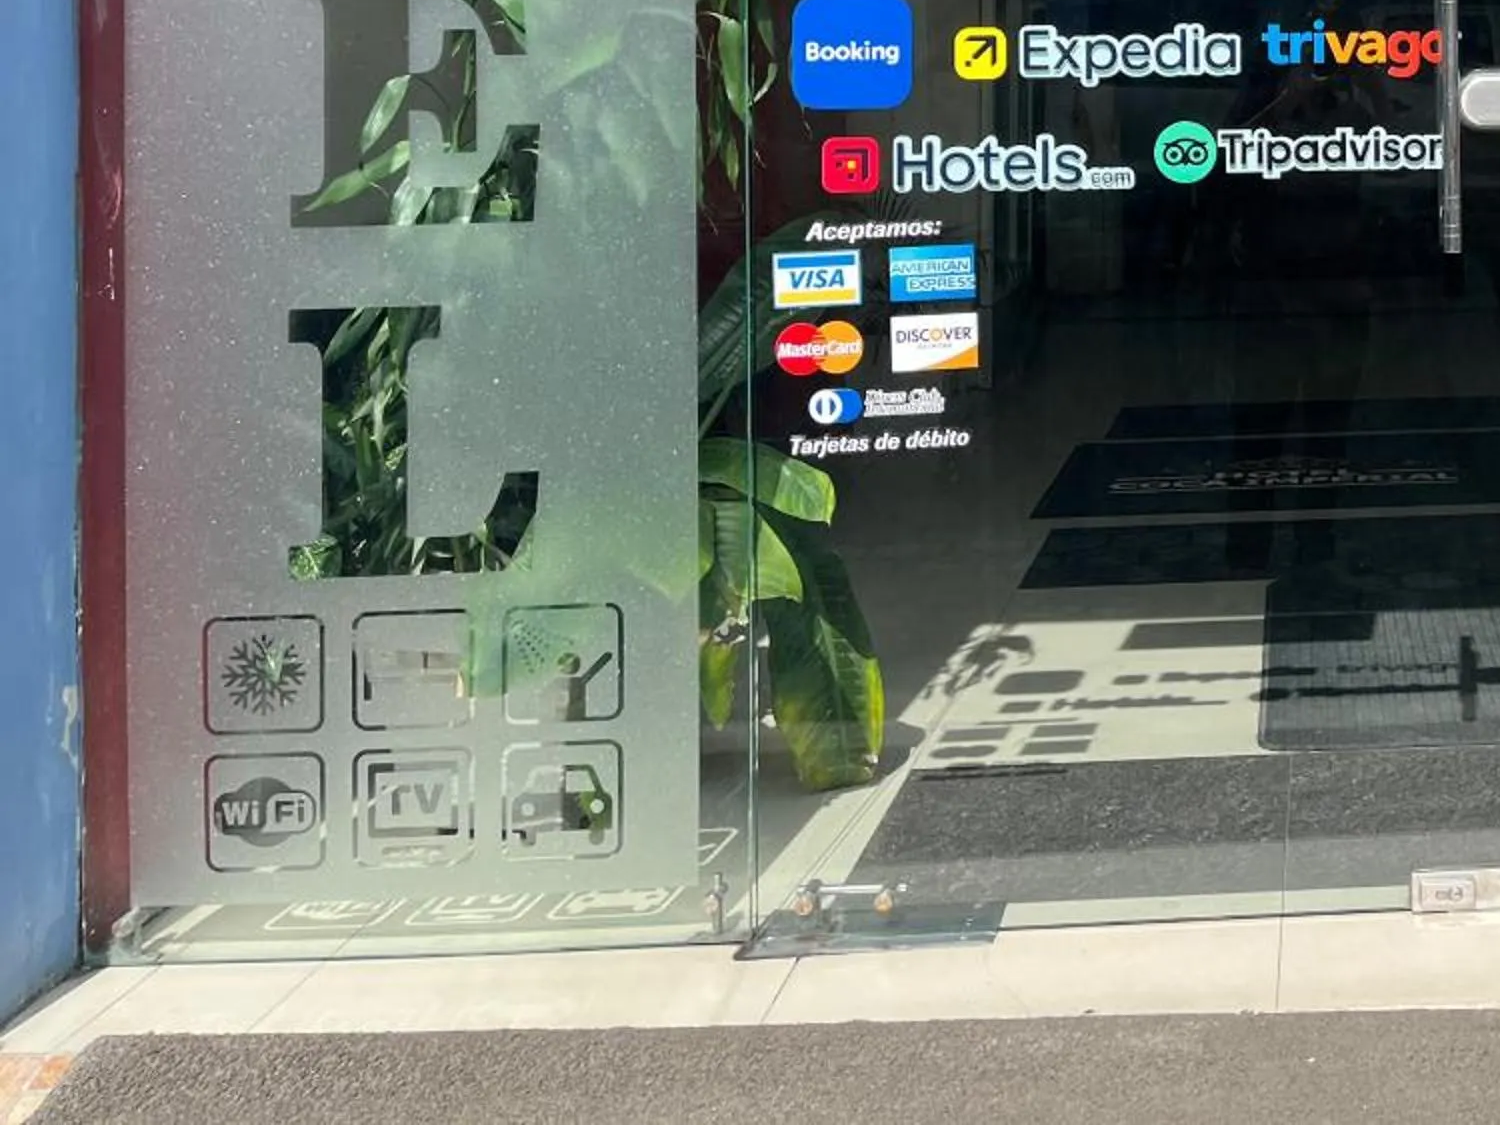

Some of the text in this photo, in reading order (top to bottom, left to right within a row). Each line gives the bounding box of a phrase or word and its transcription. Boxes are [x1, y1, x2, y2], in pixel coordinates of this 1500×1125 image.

[804, 40, 901, 65] Booking
[1020, 25, 1239, 86] Expedia
[1218, 127, 1442, 178] Tripadvisor
[805, 220, 942, 244] Aceptamos:
[892, 259, 970, 274] AMERICAN
[789, 269, 845, 290] VISA
[909, 275, 976, 290] EXPRESS
[895, 326, 972, 344] DISCOVER
[777, 340, 862, 358] MasterCard
[789, 427, 971, 459] Tarjetas de débito
[381, 783, 445, 816] TV
